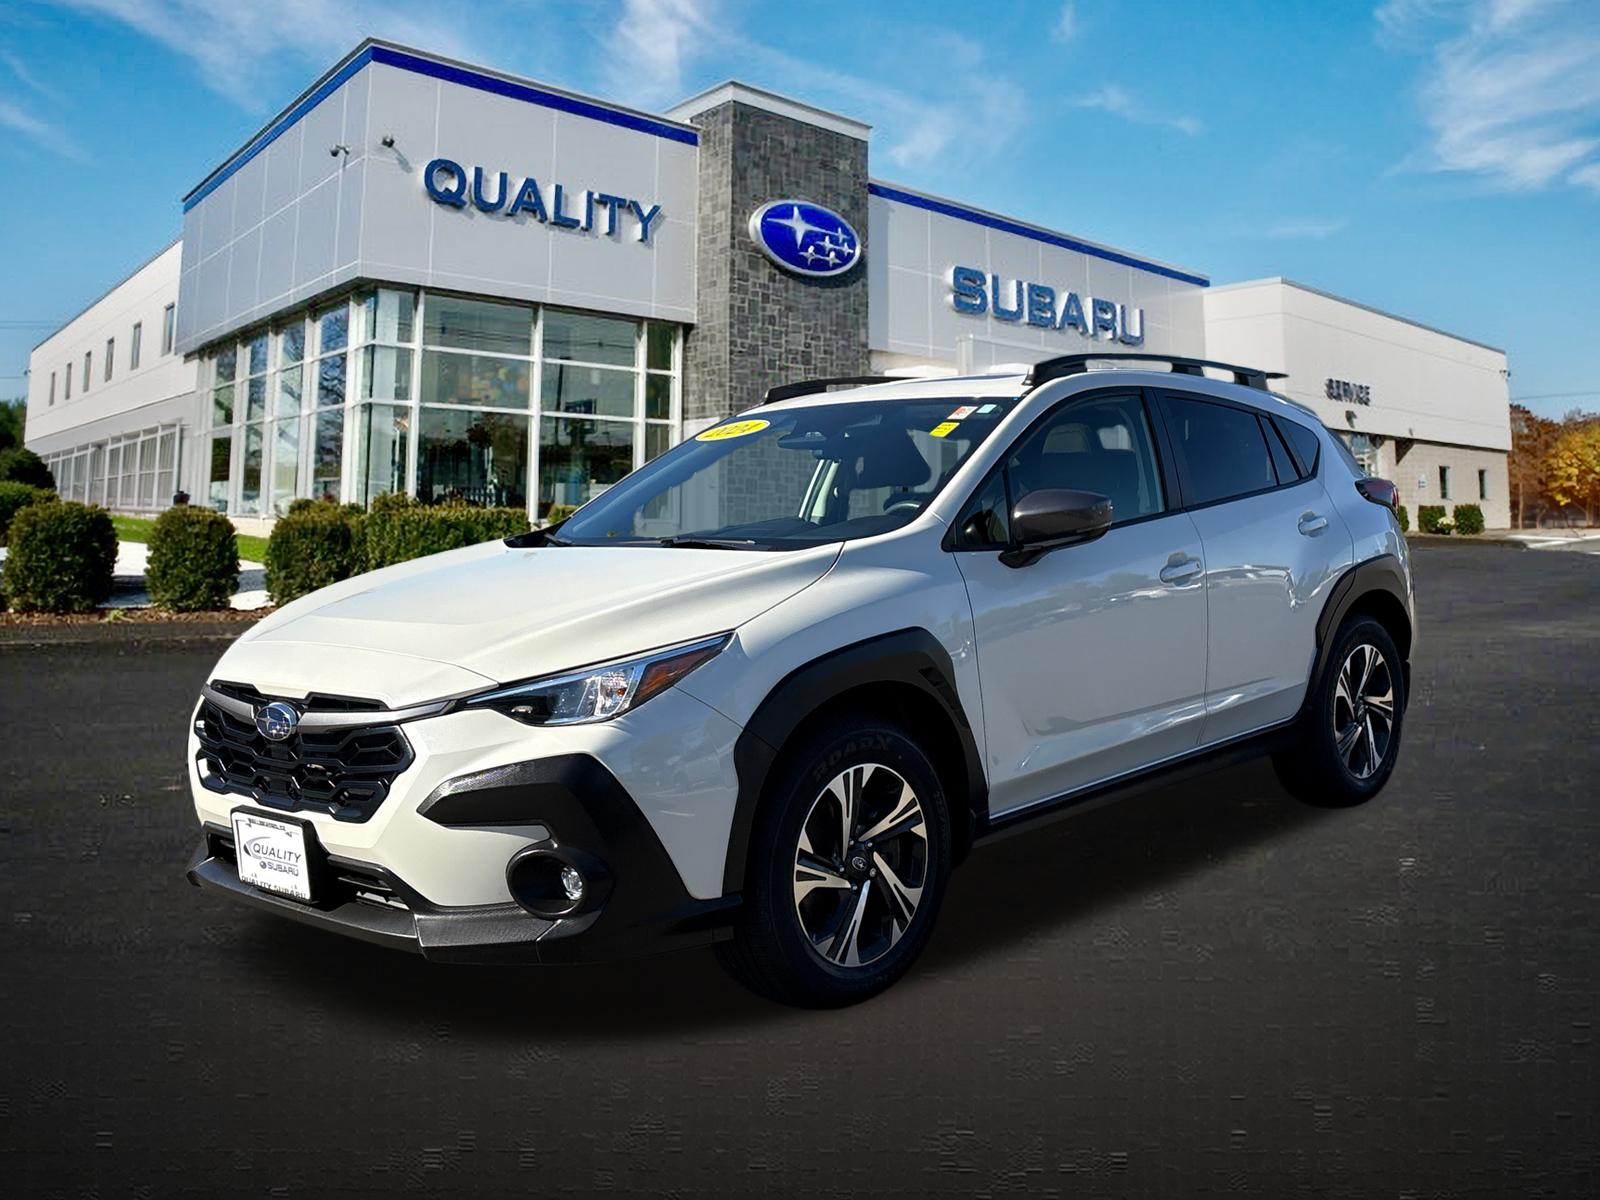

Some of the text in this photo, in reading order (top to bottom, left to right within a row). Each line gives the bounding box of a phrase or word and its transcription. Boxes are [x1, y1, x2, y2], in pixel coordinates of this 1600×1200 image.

[424, 158, 662, 242] QUALITY
[948, 265, 1145, 347] SUBARU
[1325, 378, 1371, 407] SERVICE
[252, 842, 302, 863] QUALITY
[267, 861, 299, 877] SUBARU
